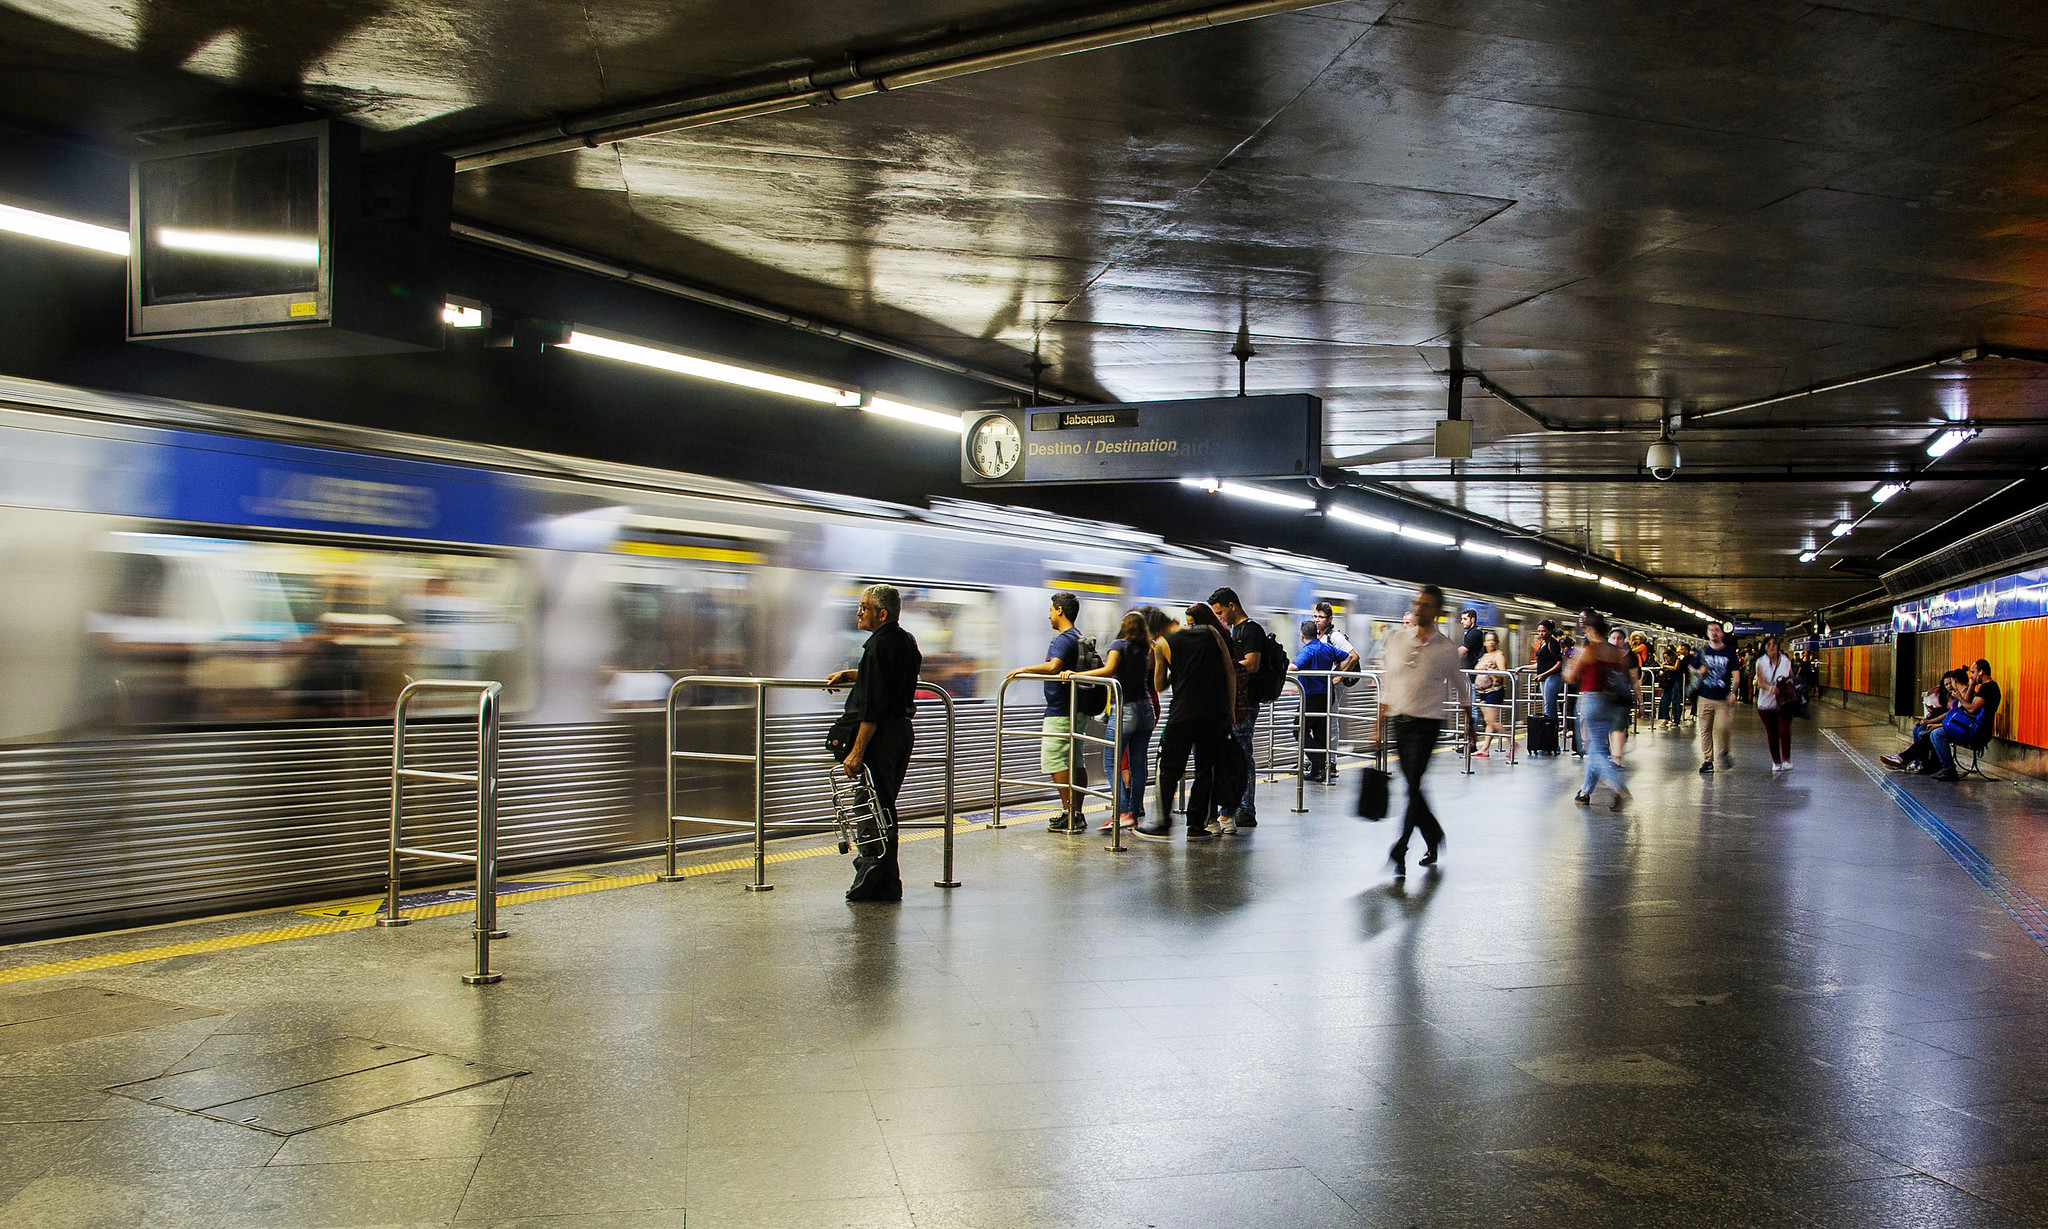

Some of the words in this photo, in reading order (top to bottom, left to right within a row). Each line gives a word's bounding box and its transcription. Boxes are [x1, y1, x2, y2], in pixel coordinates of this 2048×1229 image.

[1063, 413, 1115, 426] Jabaquara
[1014, 444, 1019, 452] 3
[1028, 441, 1082, 456] Destino
[1085, 440, 1091, 454] /
[1094, 438, 1177, 454] Destination
[981, 455, 986, 463] 8
[988, 462, 992, 470] 7
